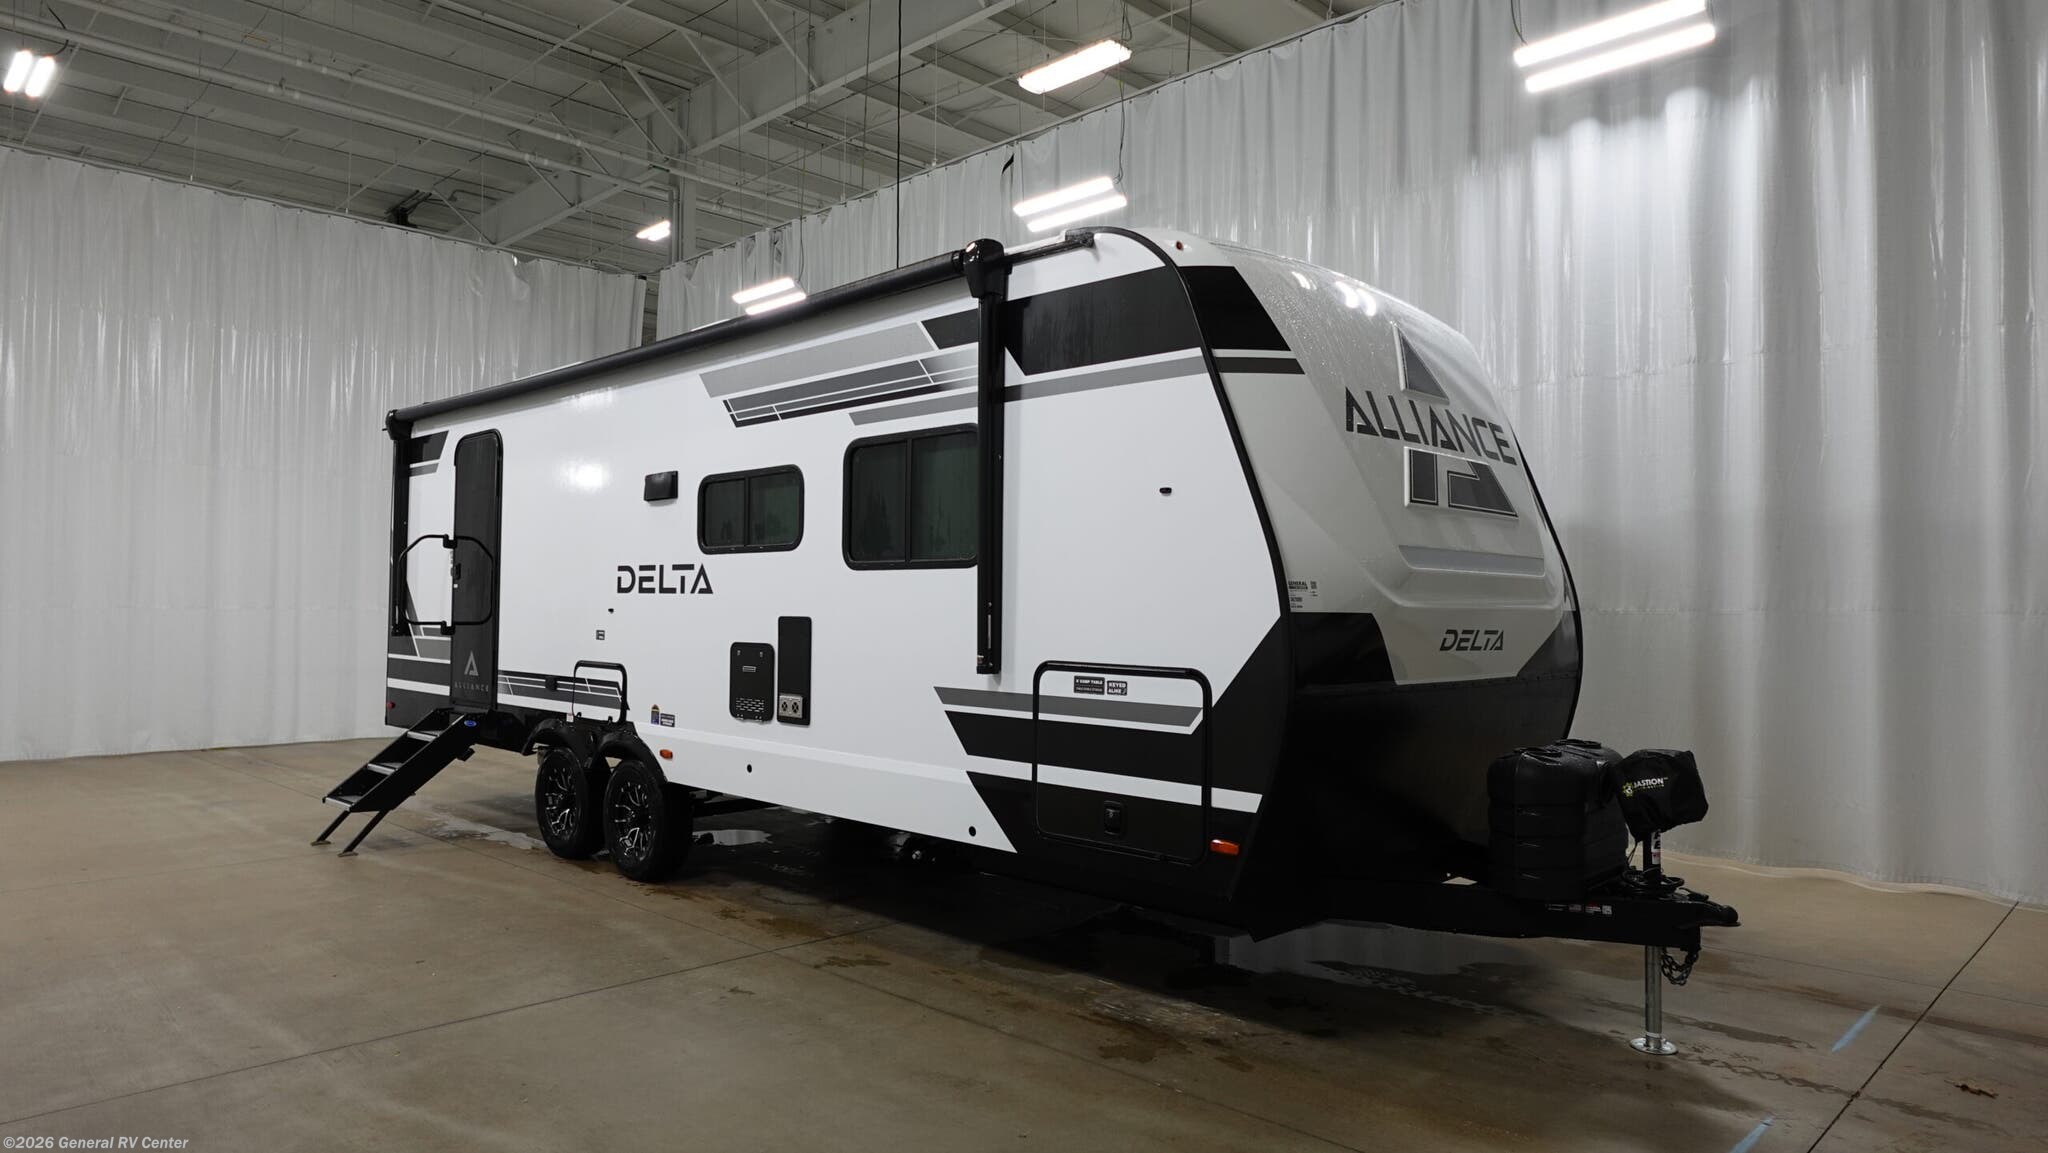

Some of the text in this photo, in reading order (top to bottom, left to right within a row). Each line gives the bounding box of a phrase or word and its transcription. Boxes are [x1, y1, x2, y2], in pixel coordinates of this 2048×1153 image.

[1345, 387, 1517, 466] ALLIANCE
[617, 563, 713, 594] DELTA
[1439, 629, 1504, 651] DELTA
